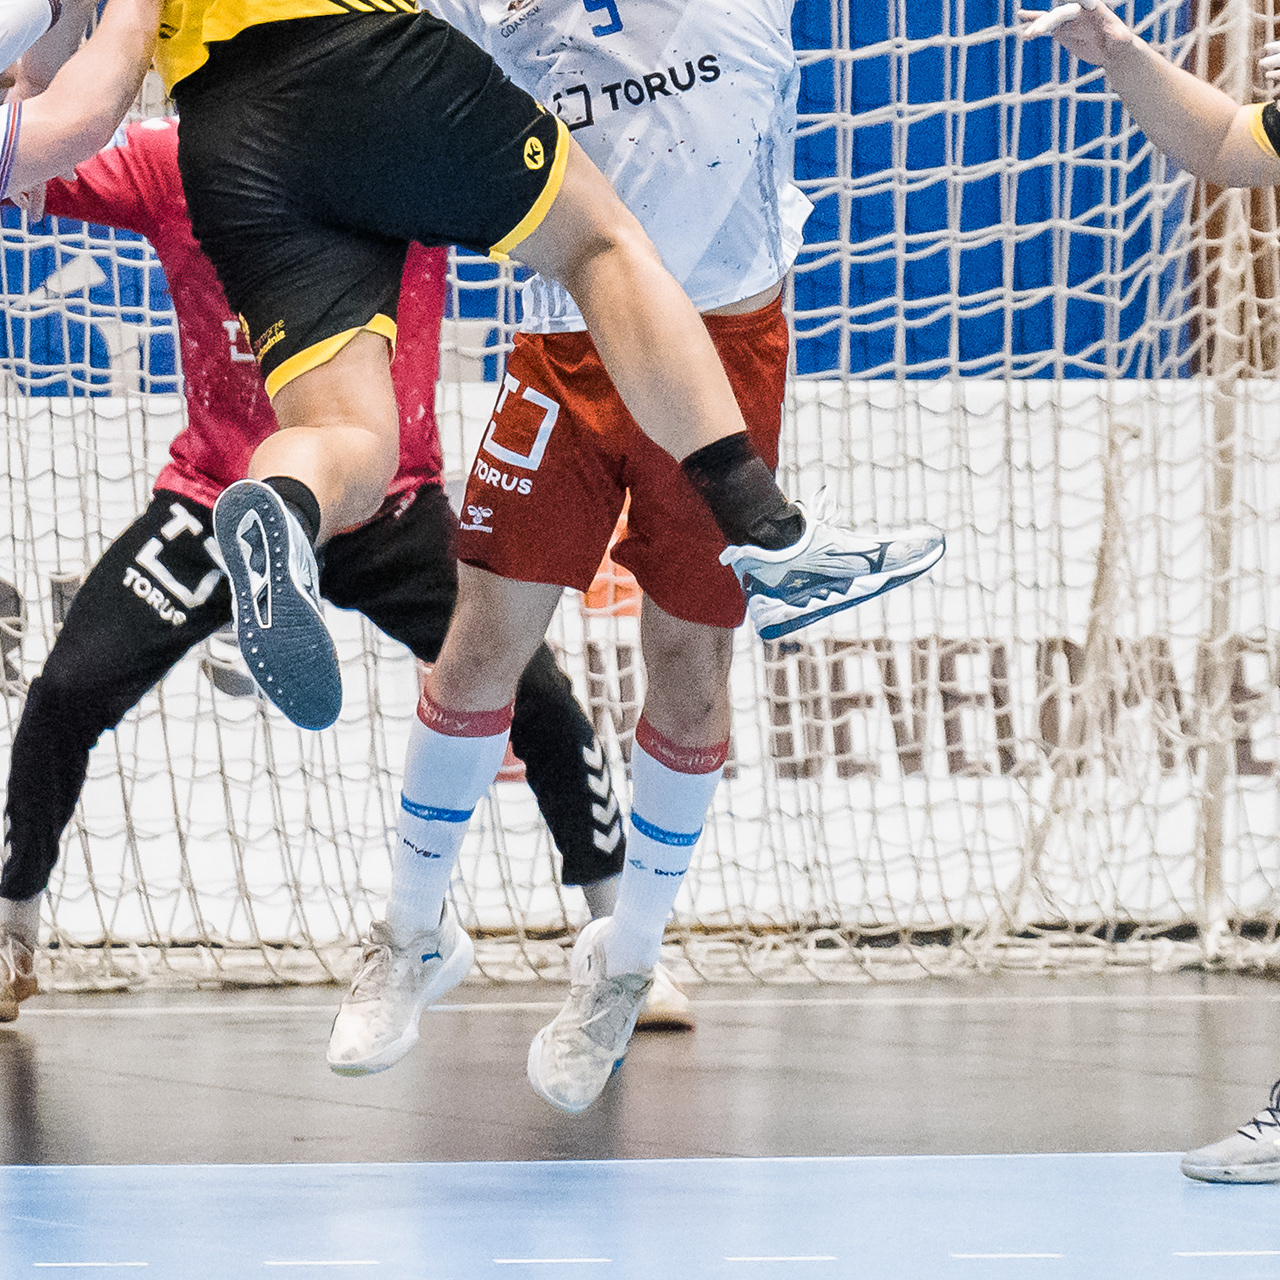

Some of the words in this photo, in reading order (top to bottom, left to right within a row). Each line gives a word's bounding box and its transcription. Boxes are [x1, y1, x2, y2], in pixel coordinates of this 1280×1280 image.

[601, 54, 721, 112] TORUS
[473, 458, 533, 495] TORUS
[122, 566, 187, 627] TORUS
